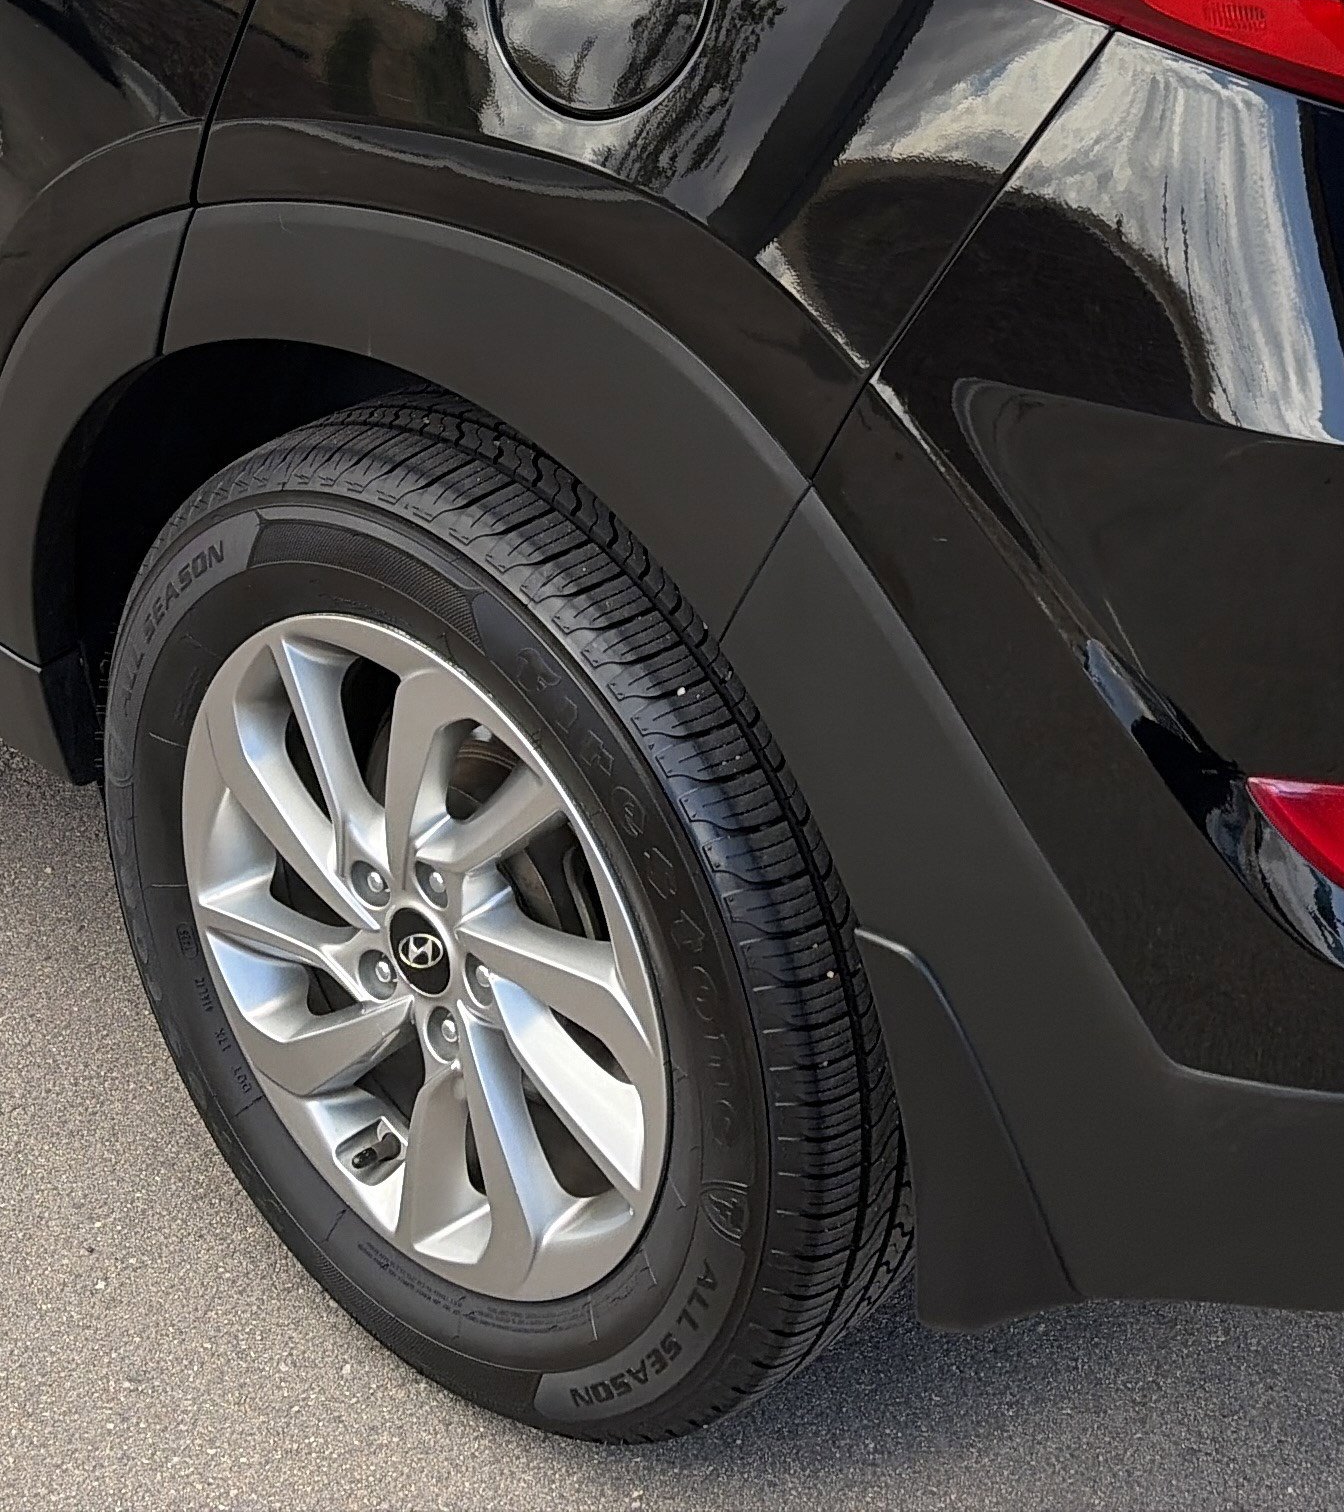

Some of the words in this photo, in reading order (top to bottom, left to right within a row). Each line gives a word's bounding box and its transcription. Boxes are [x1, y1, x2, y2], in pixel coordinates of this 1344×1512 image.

[142, 539, 225, 644] SEASON
[676, 1257, 718, 1332] ALL
[569, 1332, 683, 1409] SEASON
